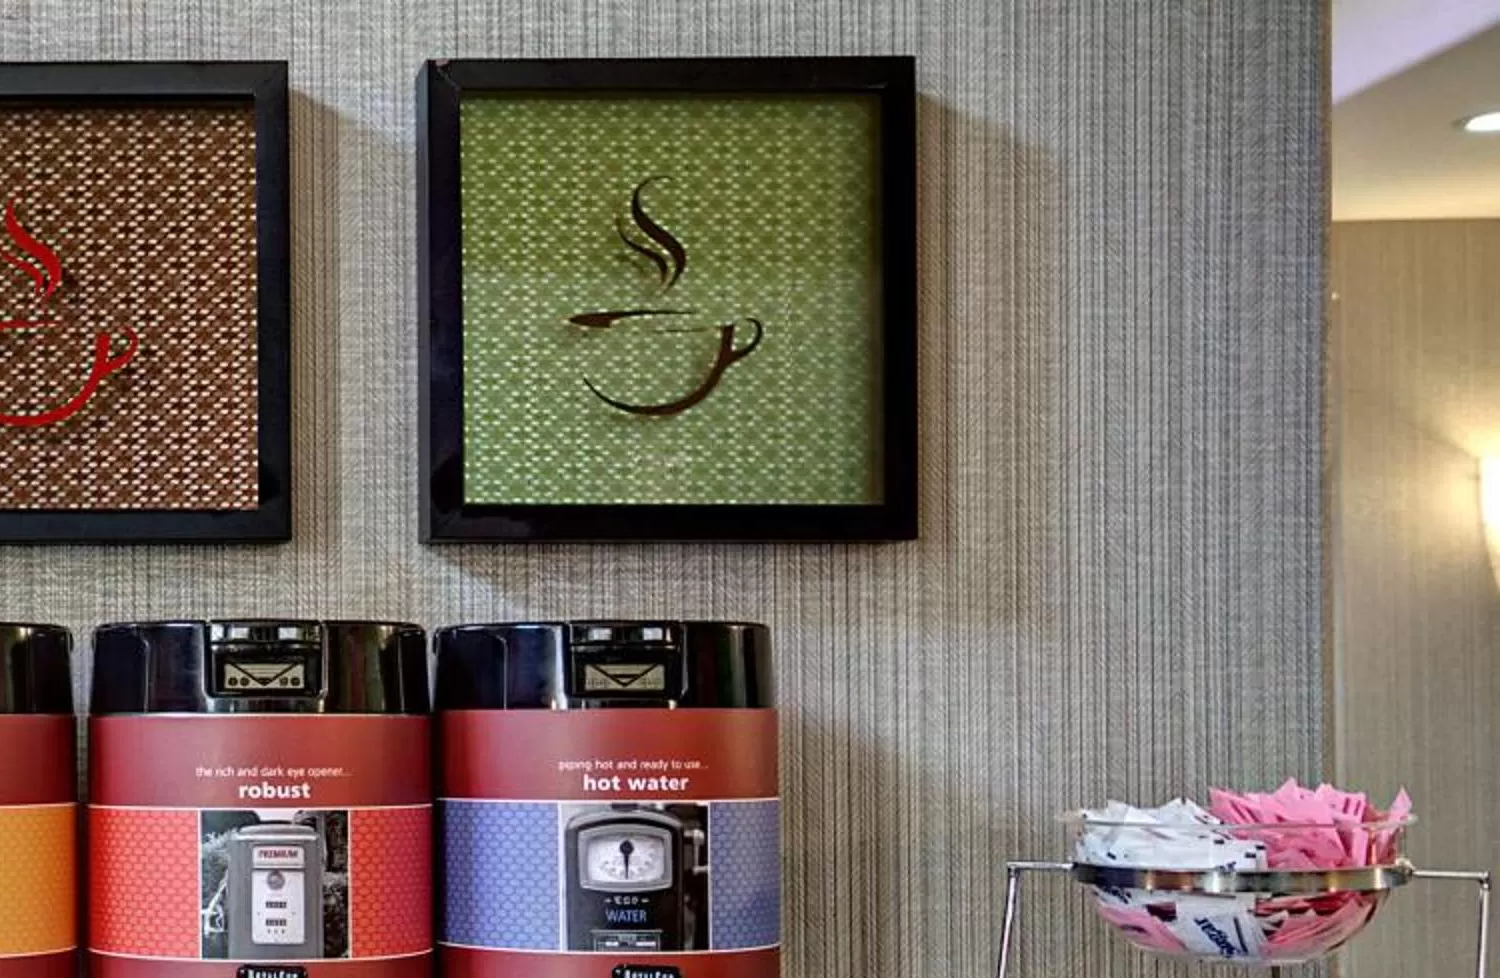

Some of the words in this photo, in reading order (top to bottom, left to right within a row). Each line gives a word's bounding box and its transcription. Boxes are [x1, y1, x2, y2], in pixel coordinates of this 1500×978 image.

[558, 759, 592, 771] piping
[595, 758, 613, 769] hot
[617, 758, 637, 769] and
[639, 758, 668, 771] ready
[672, 758, 682, 769] to
[195, 766, 213, 777] the
[215, 766, 235, 777] rich
[237, 766, 258, 777] and
[260, 766, 284, 777] dark
[287, 767, 305, 778] eye
[583, 773, 621, 791] hot
[628, 775, 689, 791] water
[239, 781, 311, 799] robust
[605, 909, 647, 923] WATER
